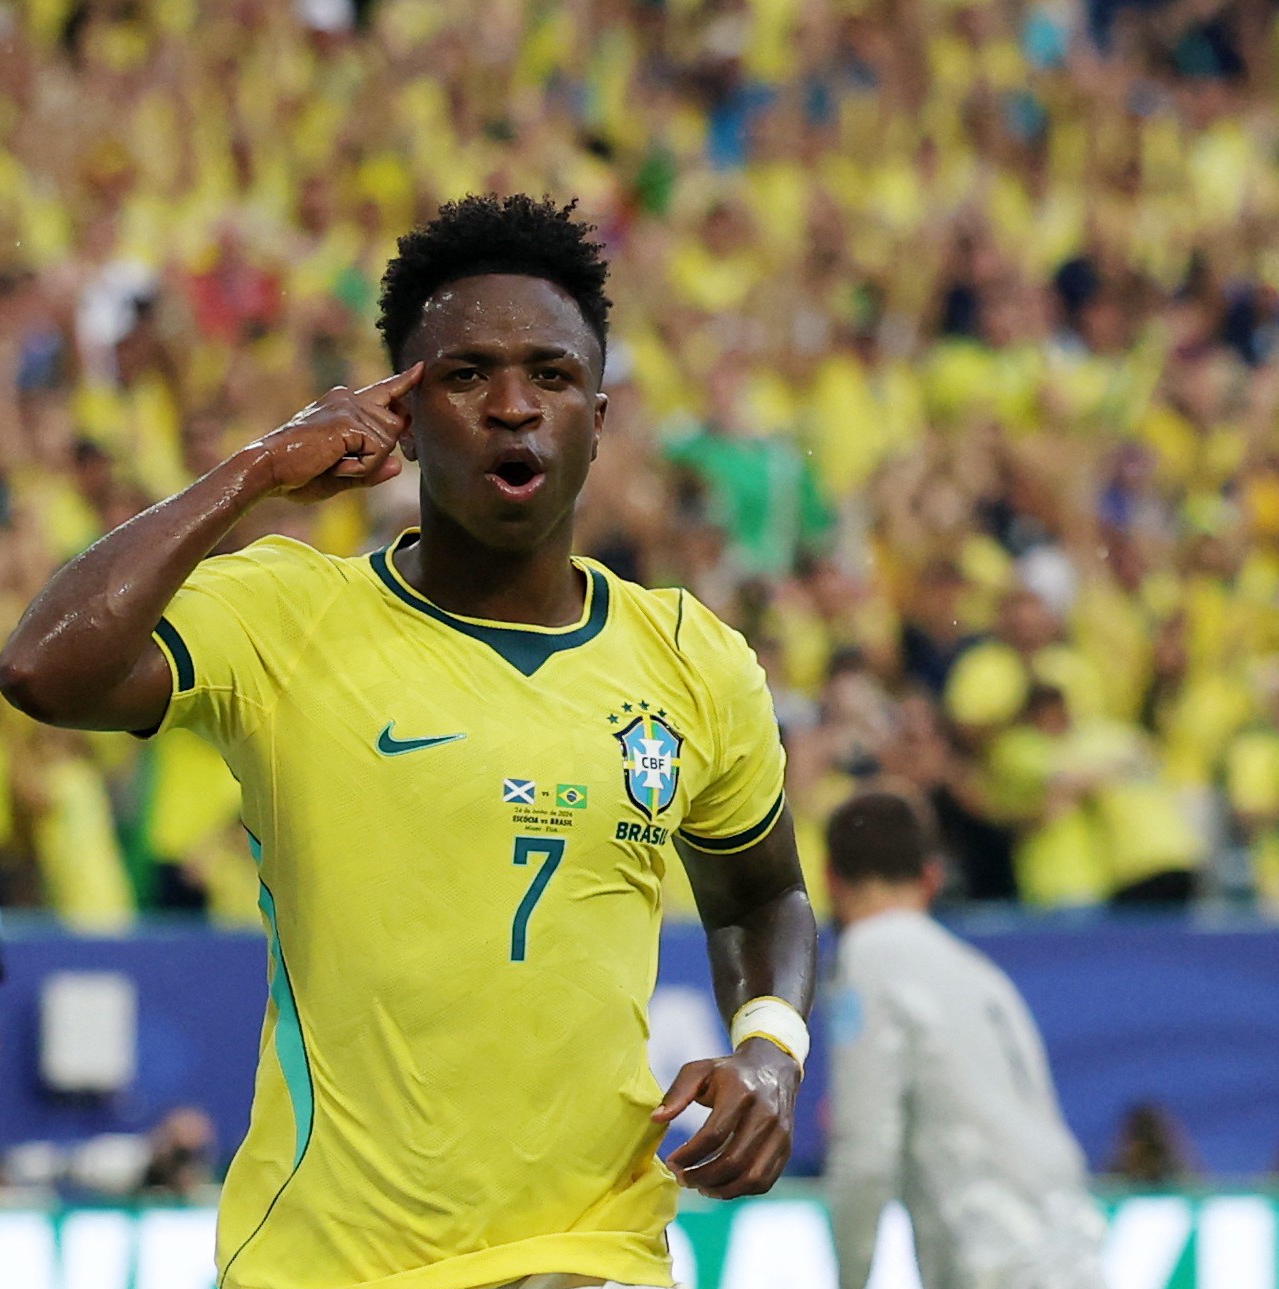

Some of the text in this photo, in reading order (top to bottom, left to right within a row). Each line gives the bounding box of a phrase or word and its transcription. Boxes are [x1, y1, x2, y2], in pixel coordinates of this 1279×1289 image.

[641, 756, 666, 770] CBF
[550, 818, 573, 826] BRASIL
[615, 821, 669, 845] BRASIL
[510, 835, 566, 962] 7
